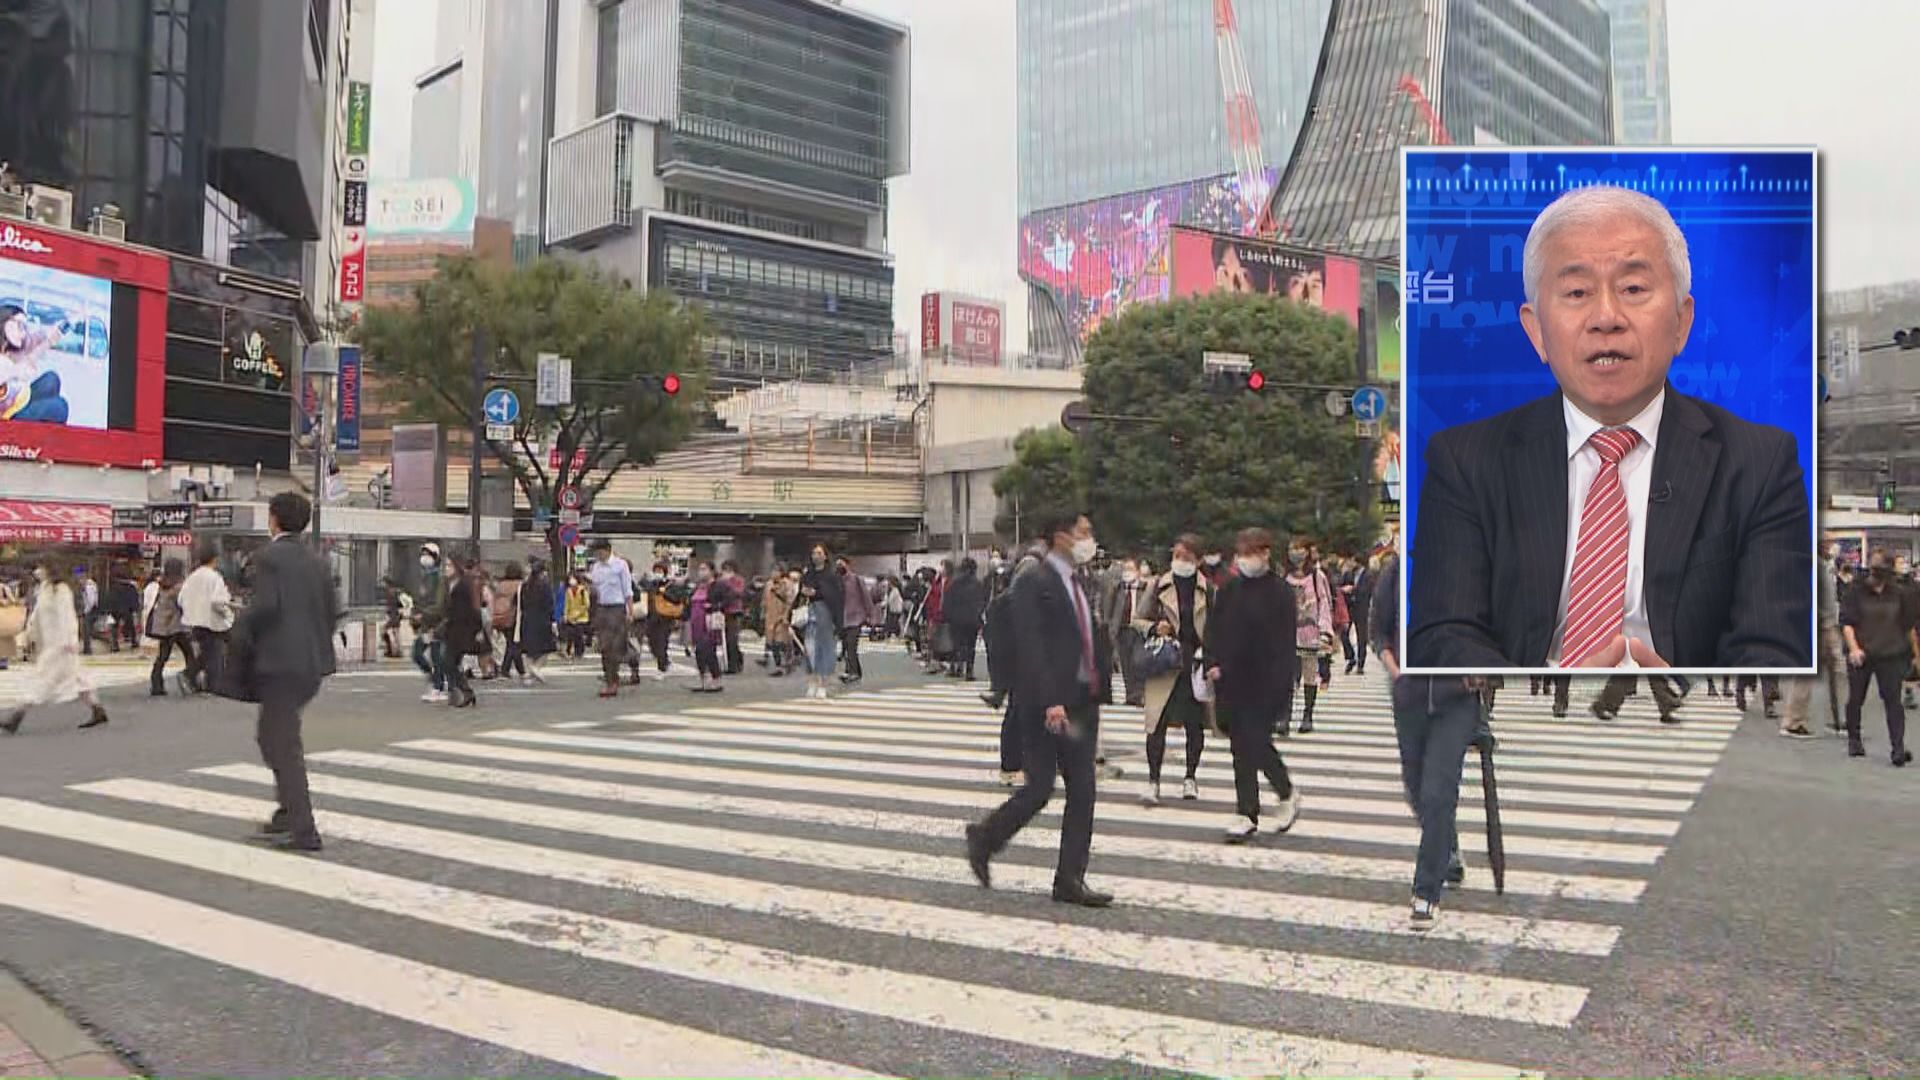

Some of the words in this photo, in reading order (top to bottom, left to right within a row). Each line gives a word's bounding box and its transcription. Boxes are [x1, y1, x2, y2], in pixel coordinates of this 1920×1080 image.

[346, 262, 360, 297] アコム
[648, 477, 794, 502] 渋谷駅
